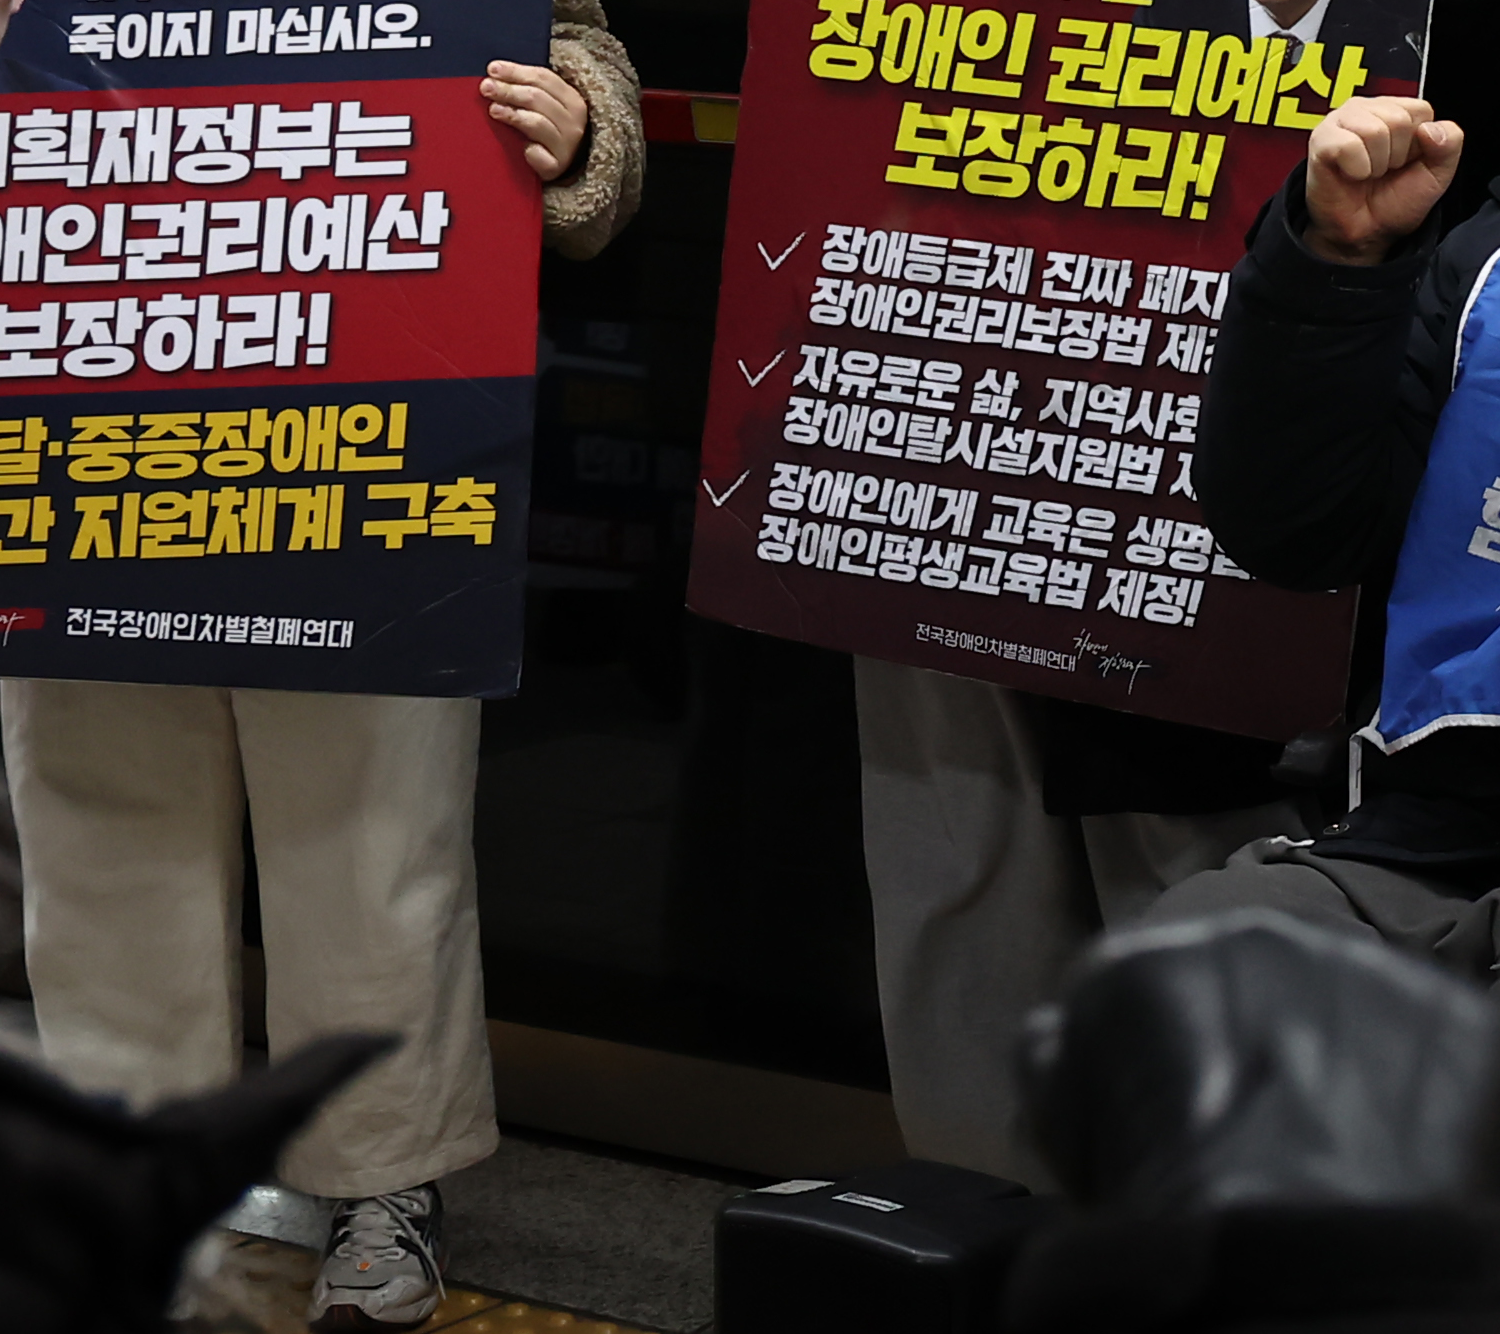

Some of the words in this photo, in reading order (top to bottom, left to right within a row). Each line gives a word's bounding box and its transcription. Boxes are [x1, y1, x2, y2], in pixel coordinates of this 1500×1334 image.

[67, 8, 213, 60] 죽이지
[225, 3, 432, 54] 마십시오.
[1045, 17, 1367, 130] 권리예산
[885, 103, 1226, 220] 보장하라!
[821, 223, 1030, 288] 장애등급제
[1040, 250, 1132, 307] 진짜
[808, 277, 1152, 366] 장애인권리보장법
[791, 344, 962, 412] 자유로운
[972, 369, 1023, 421] 삶,
[782, 396, 1165, 495] 장애인탈시설지원법
[70, 484, 343, 560] 지원체계
[362, 477, 496, 547] 구축
[768, 463, 977, 538] 장애인에게
[982, 494, 1116, 558] 교육은
[756, 515, 1092, 610] 장애인평생교육법
[1098, 569, 1204, 628] 제정!
[66, 607, 354, 649] 전국장애인차별철폐연대
[916, 622, 1077, 673] 전국장애인차별철폐연대
